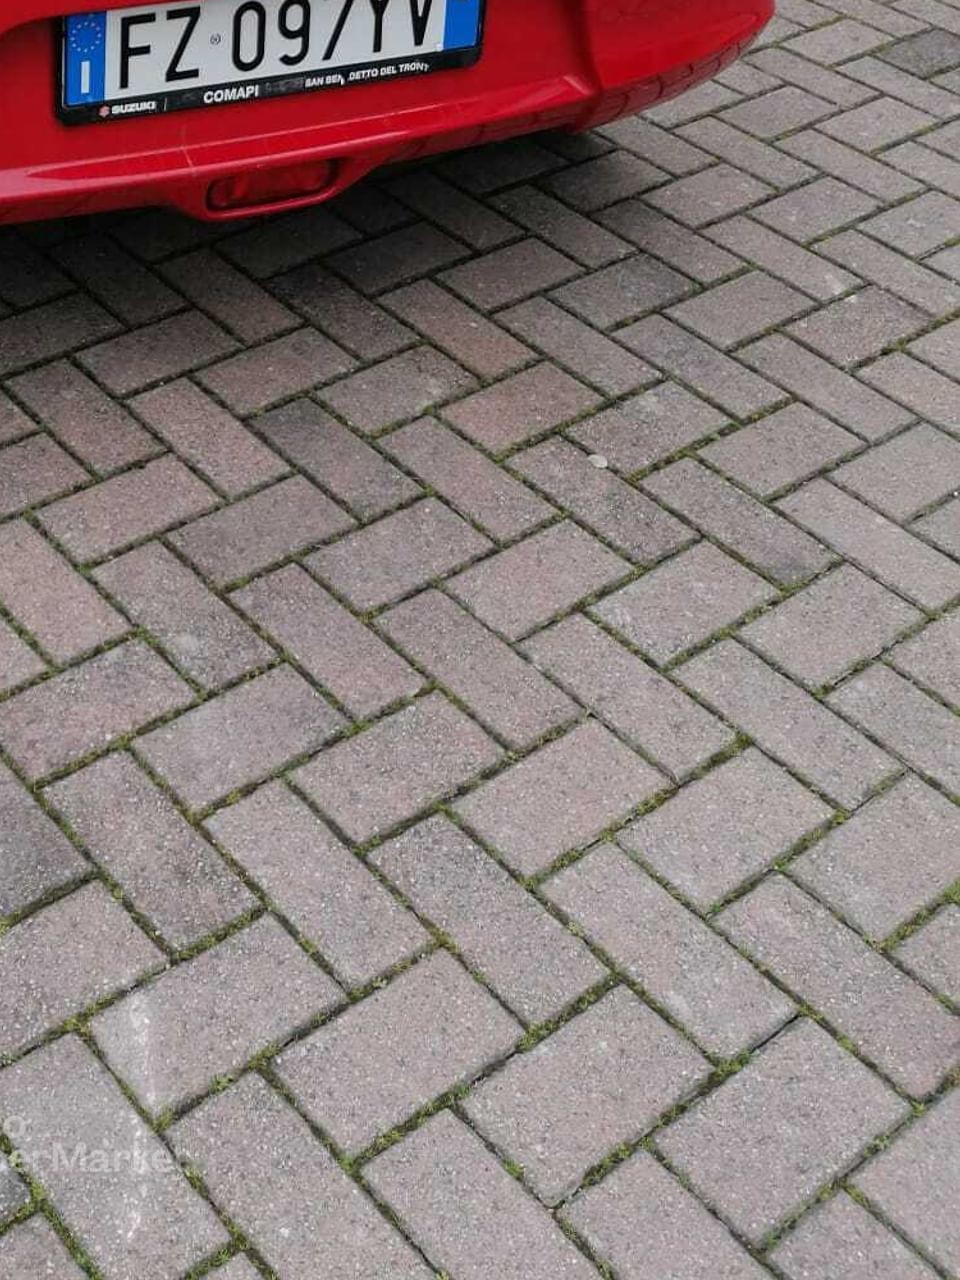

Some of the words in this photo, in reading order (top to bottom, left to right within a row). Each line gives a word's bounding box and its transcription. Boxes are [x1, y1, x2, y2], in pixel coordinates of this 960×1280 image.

[119, 6, 202, 90] FZ
[380, 65, 397, 77] DEL
[203, 84, 259, 104] COMAPI
[111, 99, 156, 115] SUZUKI
